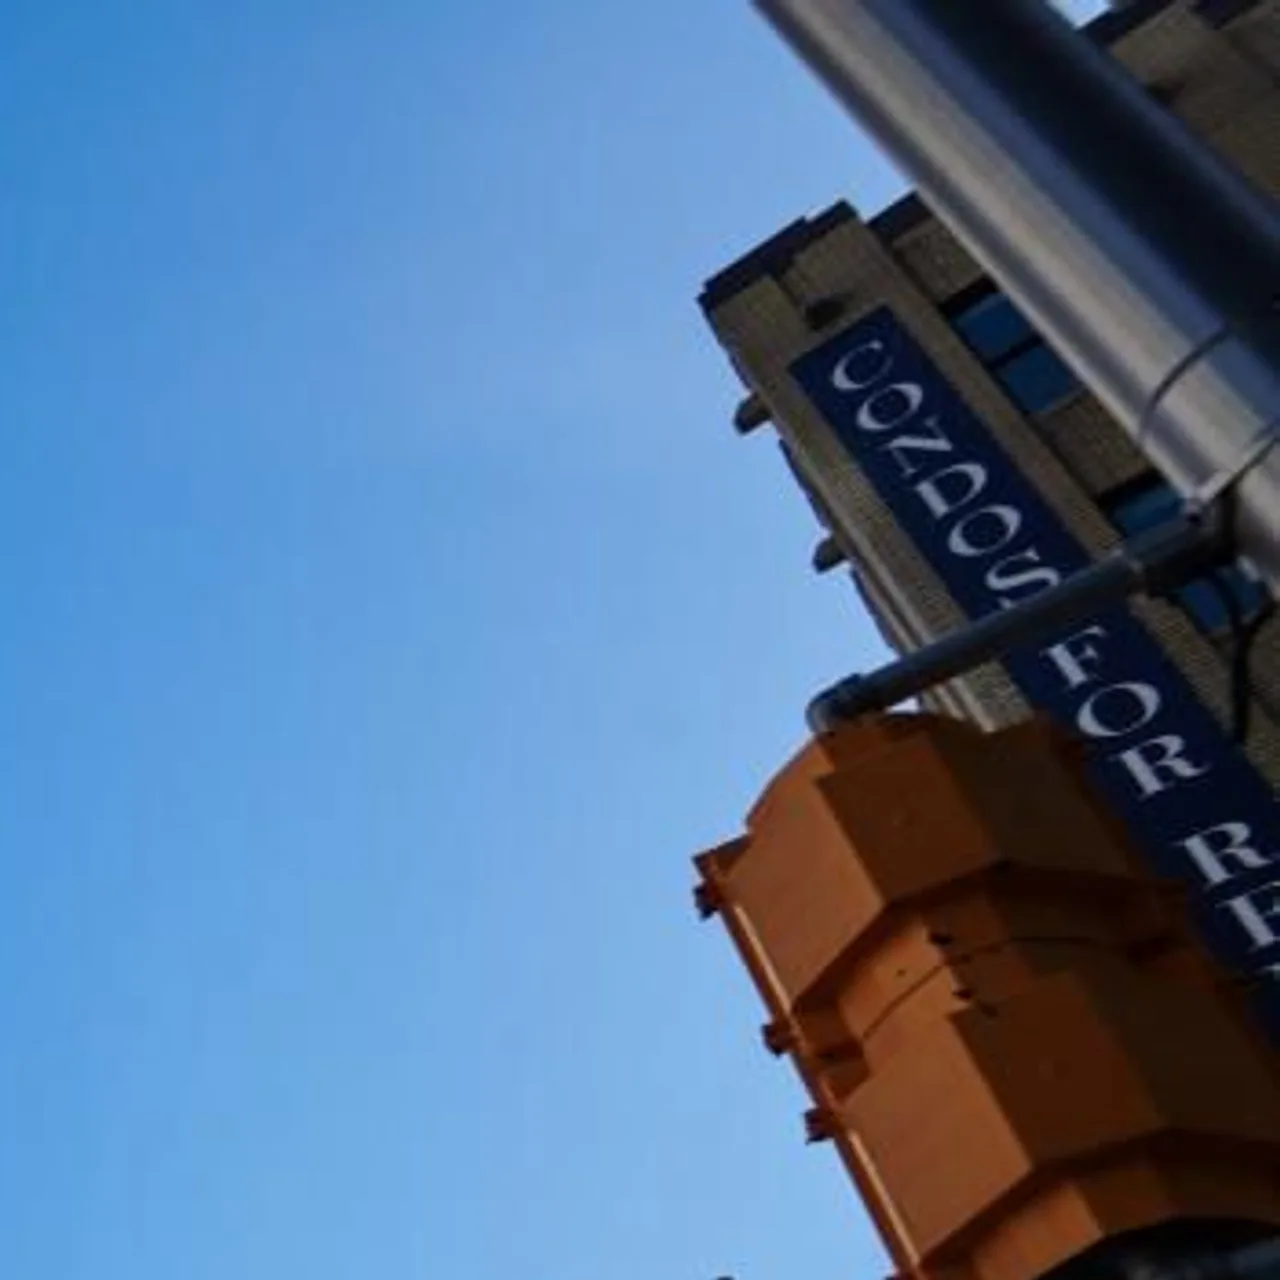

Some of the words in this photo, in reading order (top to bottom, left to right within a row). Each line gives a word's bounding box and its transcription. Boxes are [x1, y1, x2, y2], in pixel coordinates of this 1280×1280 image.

[831, 339, 1060, 610] CONDOS
[1042, 624, 1213, 798] FOR
[1169, 820, 1280, 980] RE
